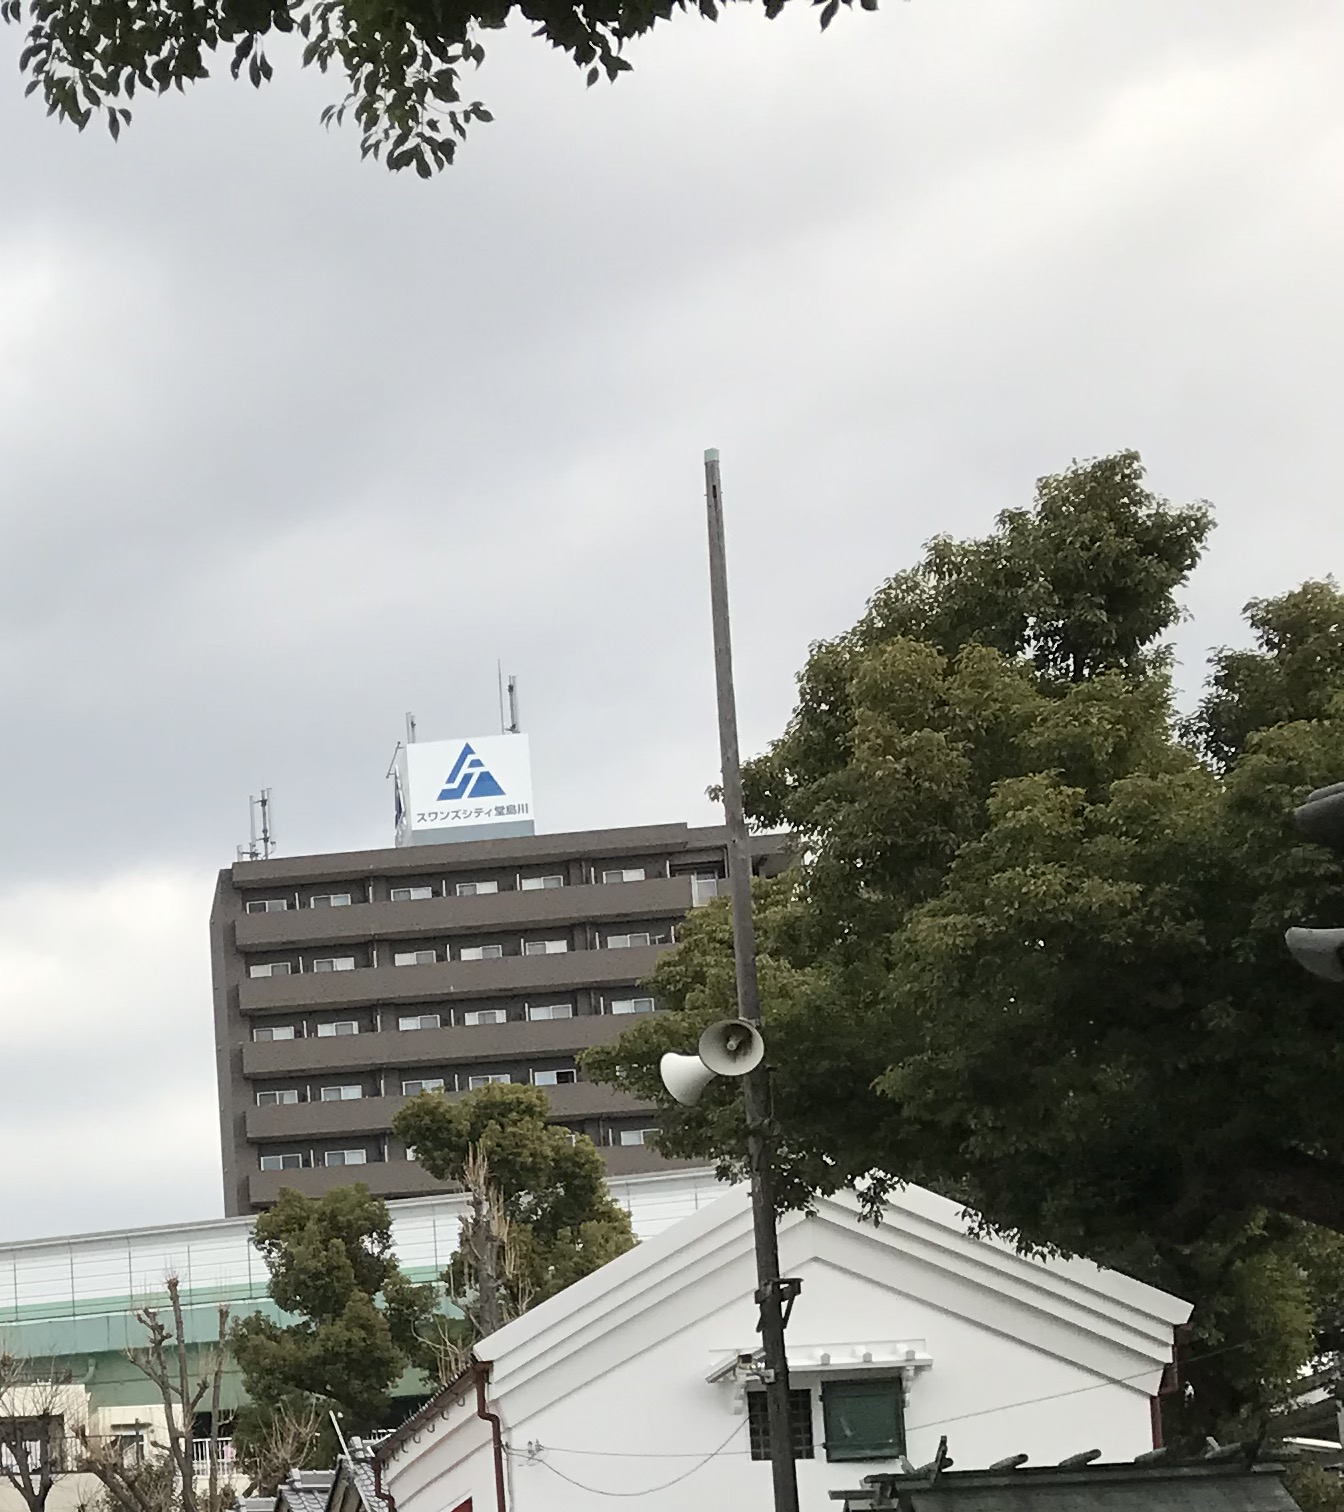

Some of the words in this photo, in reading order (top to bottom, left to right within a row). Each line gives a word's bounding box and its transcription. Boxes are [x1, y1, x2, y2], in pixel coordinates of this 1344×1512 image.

[416, 803, 529, 824] スワンズシティ堂島川
